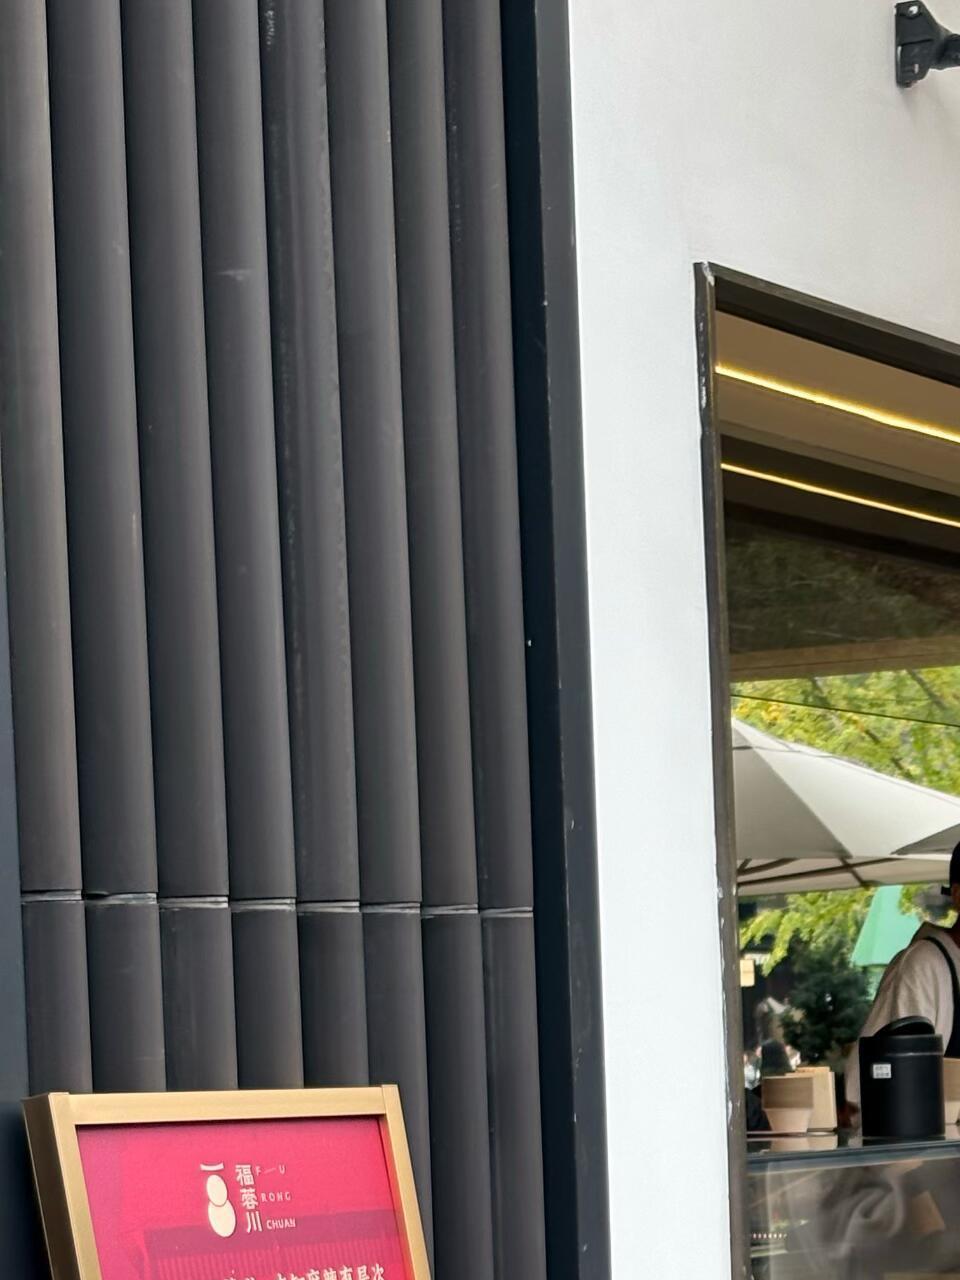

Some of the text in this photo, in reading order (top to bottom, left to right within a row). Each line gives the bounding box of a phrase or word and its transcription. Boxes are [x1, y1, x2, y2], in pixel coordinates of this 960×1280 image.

[235, 1164, 263, 1233] 福蓉川
[260, 1191, 291, 1203] RONG
[266, 1218, 296, 1230] CHUAN
